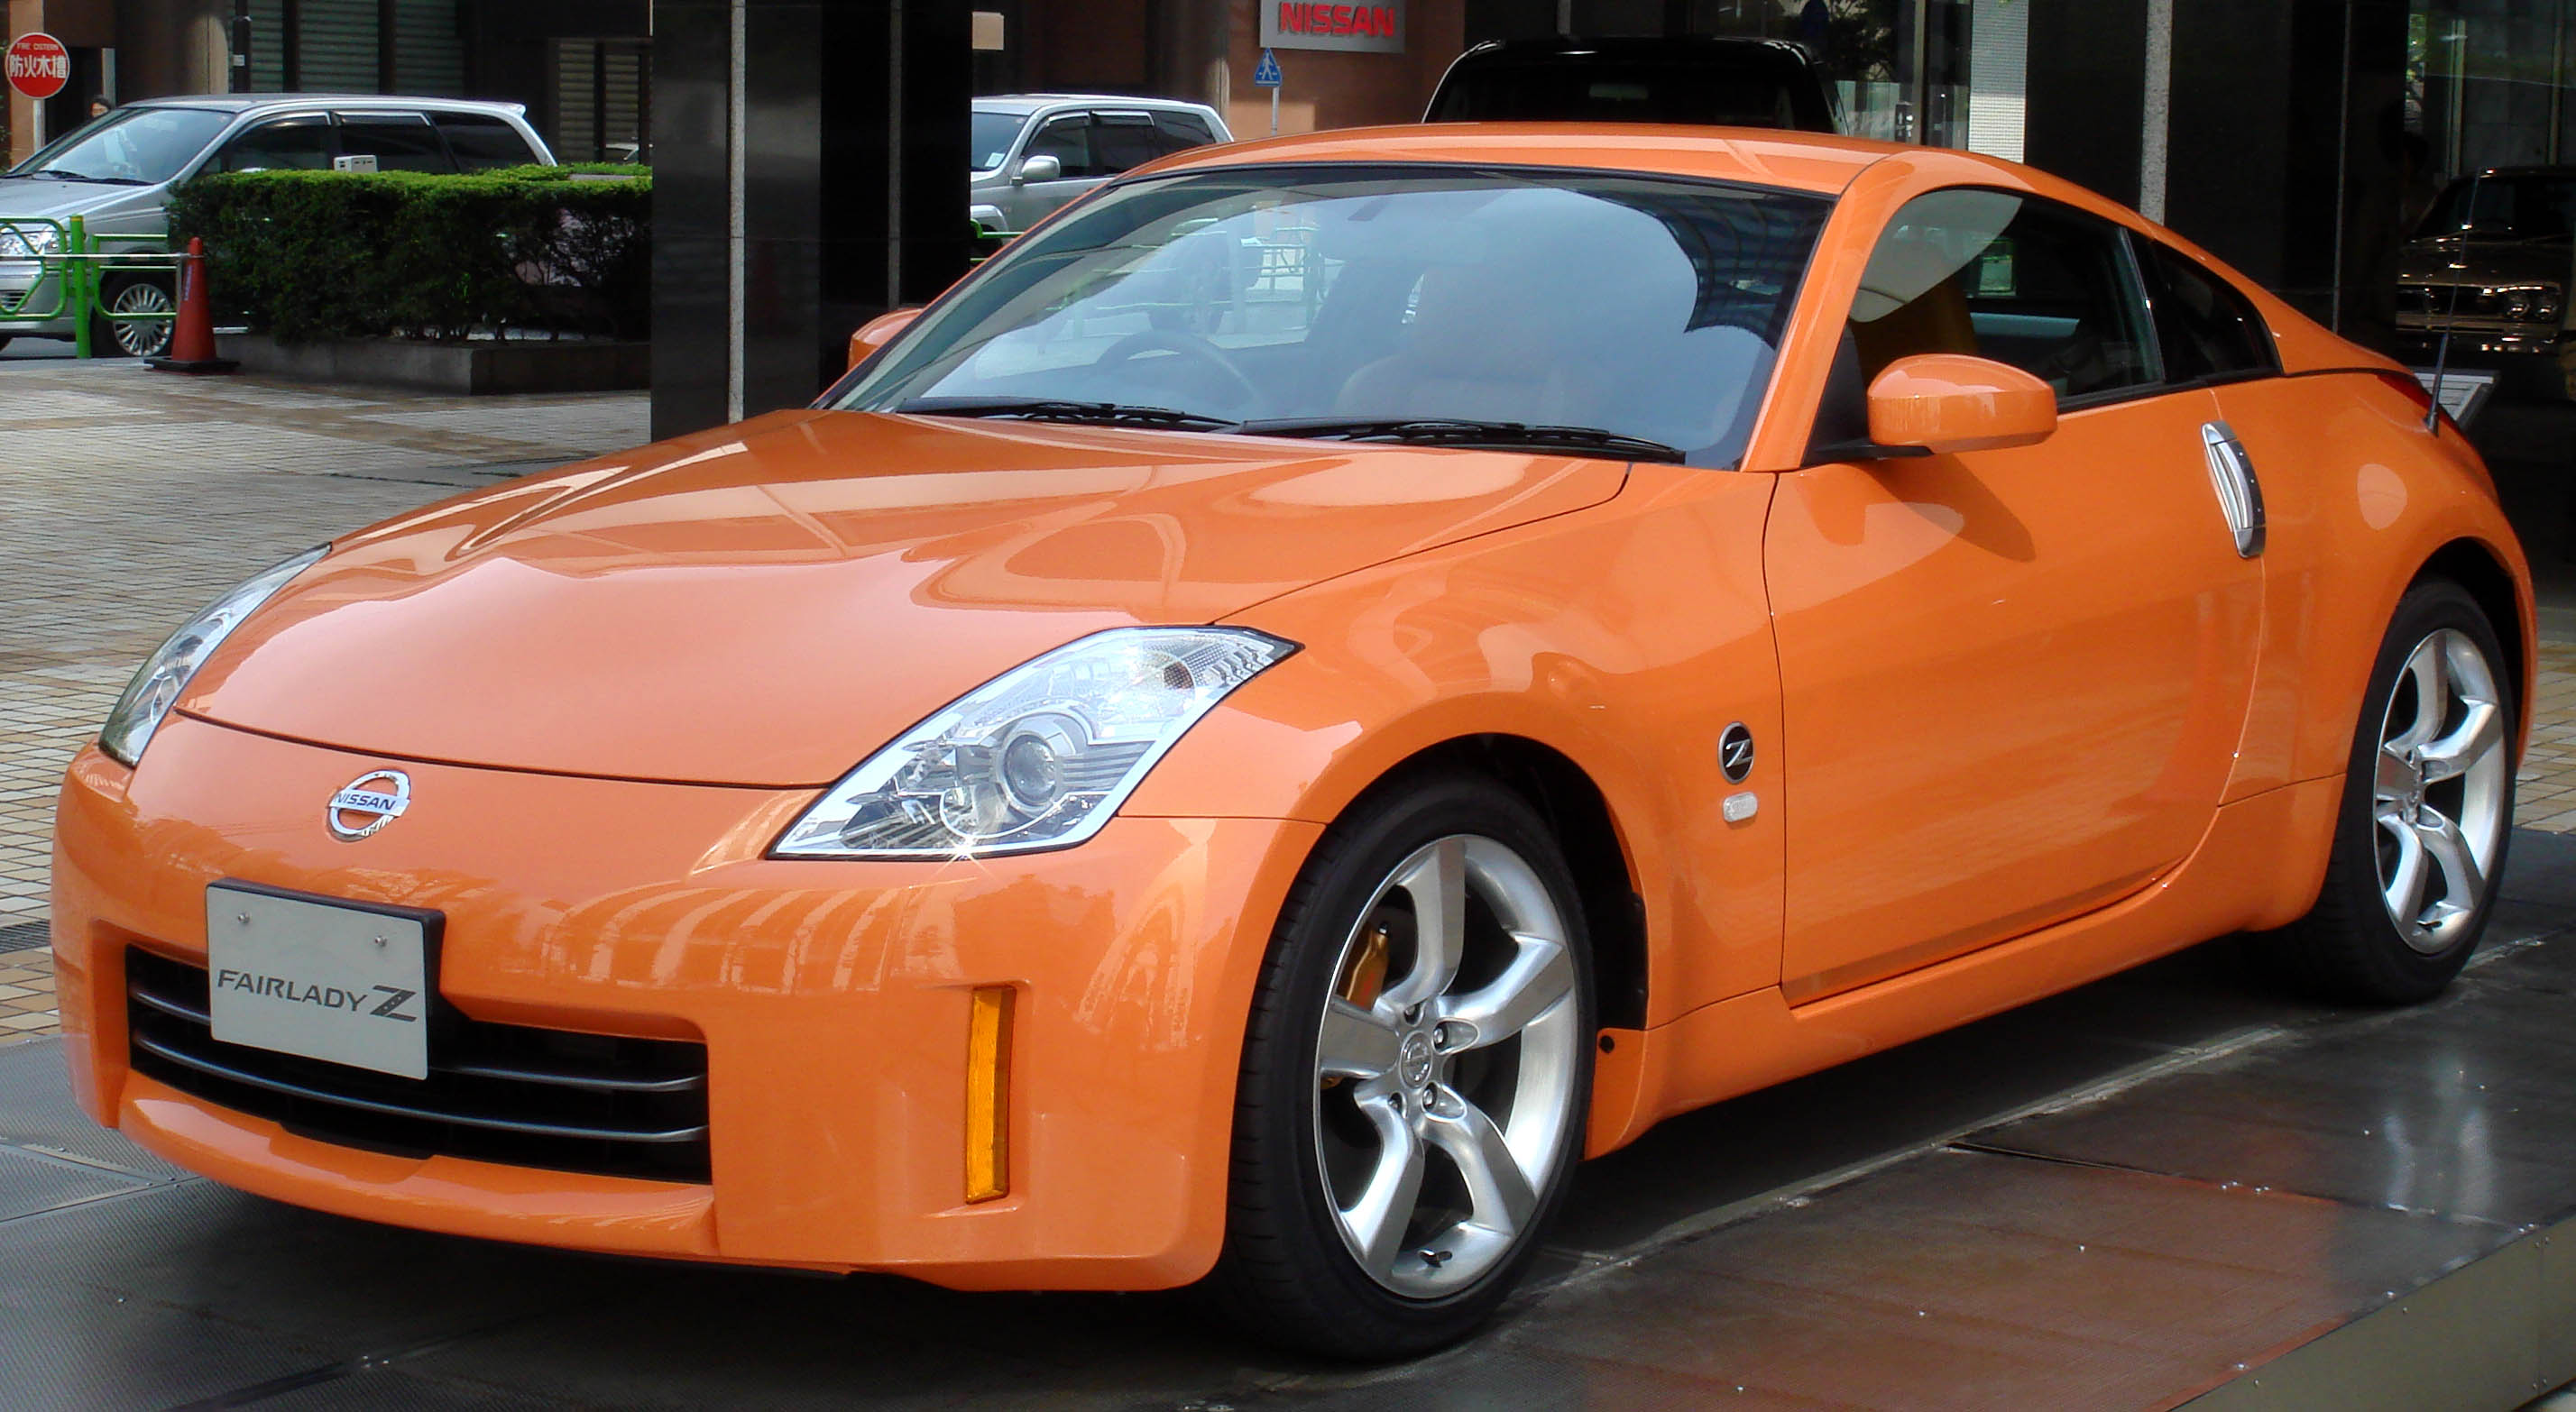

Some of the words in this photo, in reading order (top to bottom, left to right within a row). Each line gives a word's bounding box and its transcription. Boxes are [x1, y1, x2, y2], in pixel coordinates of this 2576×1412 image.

[1279, 2, 1394, 37] NISSAN
[1725, 738, 1753, 768] Z
[335, 792, 397, 811] NISSAN
[217, 968, 368, 1012] FAIRLADY
[370, 985, 418, 1022] Z
